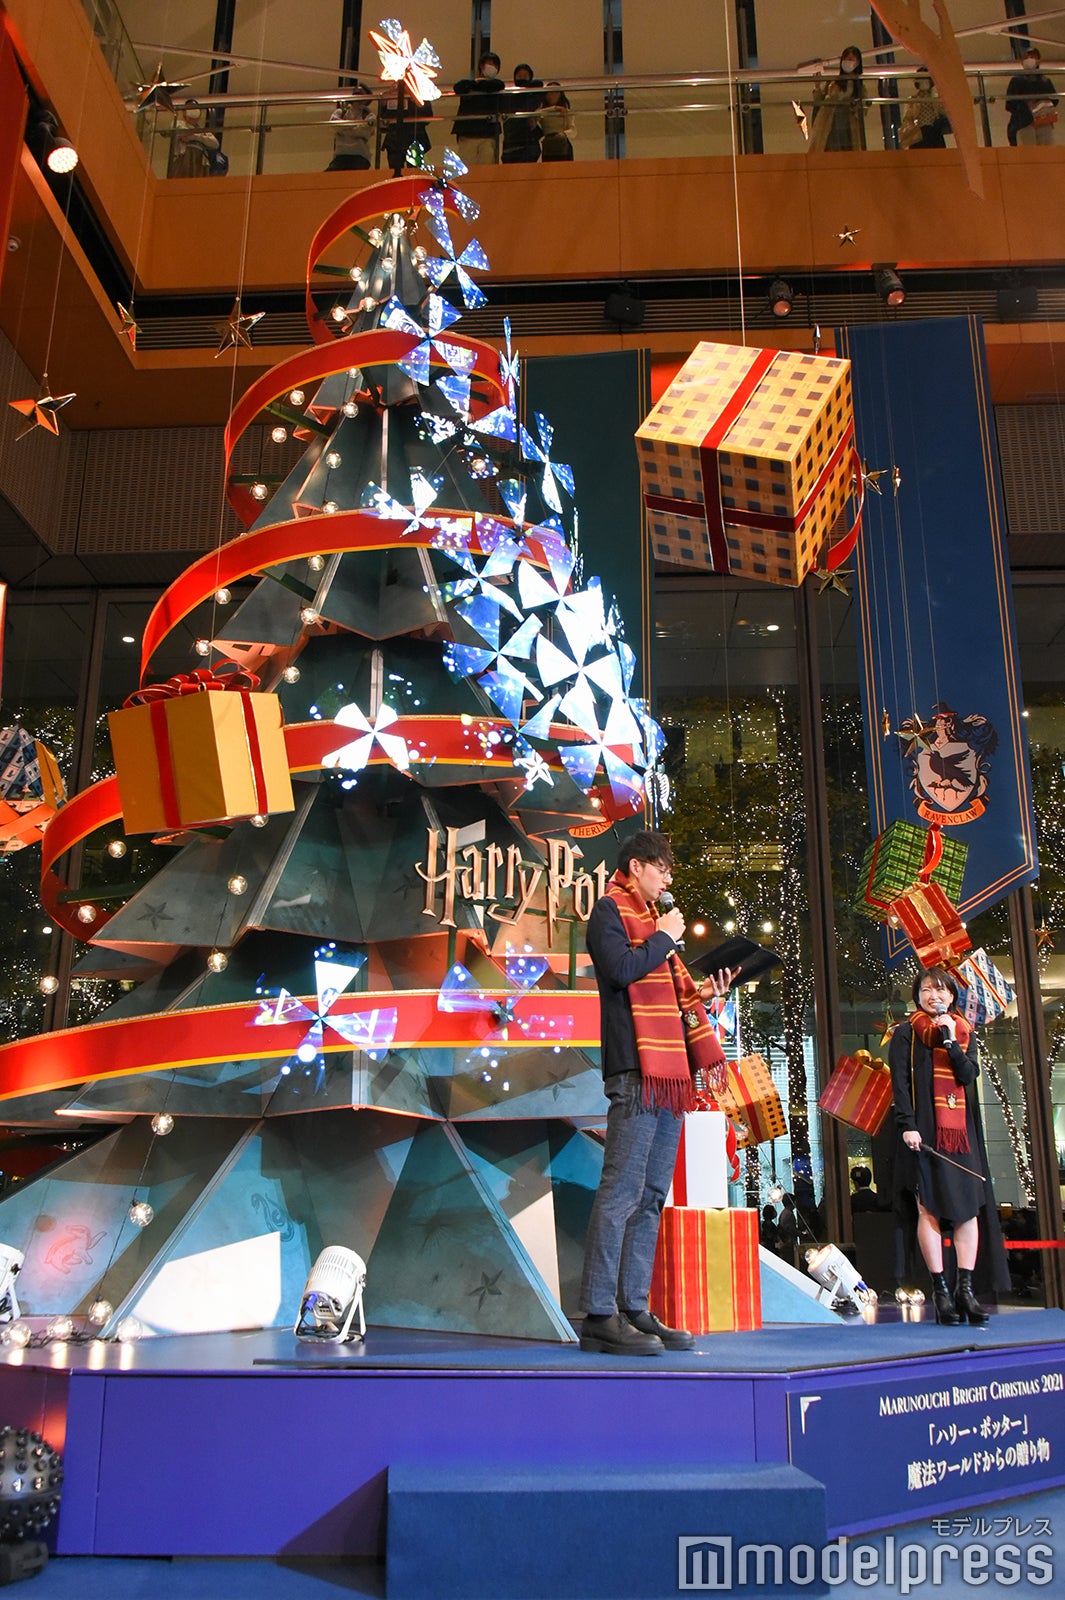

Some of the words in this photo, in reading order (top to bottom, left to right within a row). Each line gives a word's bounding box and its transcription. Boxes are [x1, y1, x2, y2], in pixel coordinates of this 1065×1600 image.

[924, 809, 977, 824] RAVENCLAW
[415, 826, 543, 928] Harry
[545, 838, 618, 948] Pot
[879, 1391, 950, 1417] MARUNOUCHI
[952, 1386, 988, 1406] BRIGHT
[989, 1379, 1040, 1400] CHRISTMAS
[1041, 1373, 1064, 1393] 2021
[928, 1413, 1029, 1446] 「ハリー・ポッター」
[907, 1436, 1050, 1491] 魔法ワールドからの贈り物
